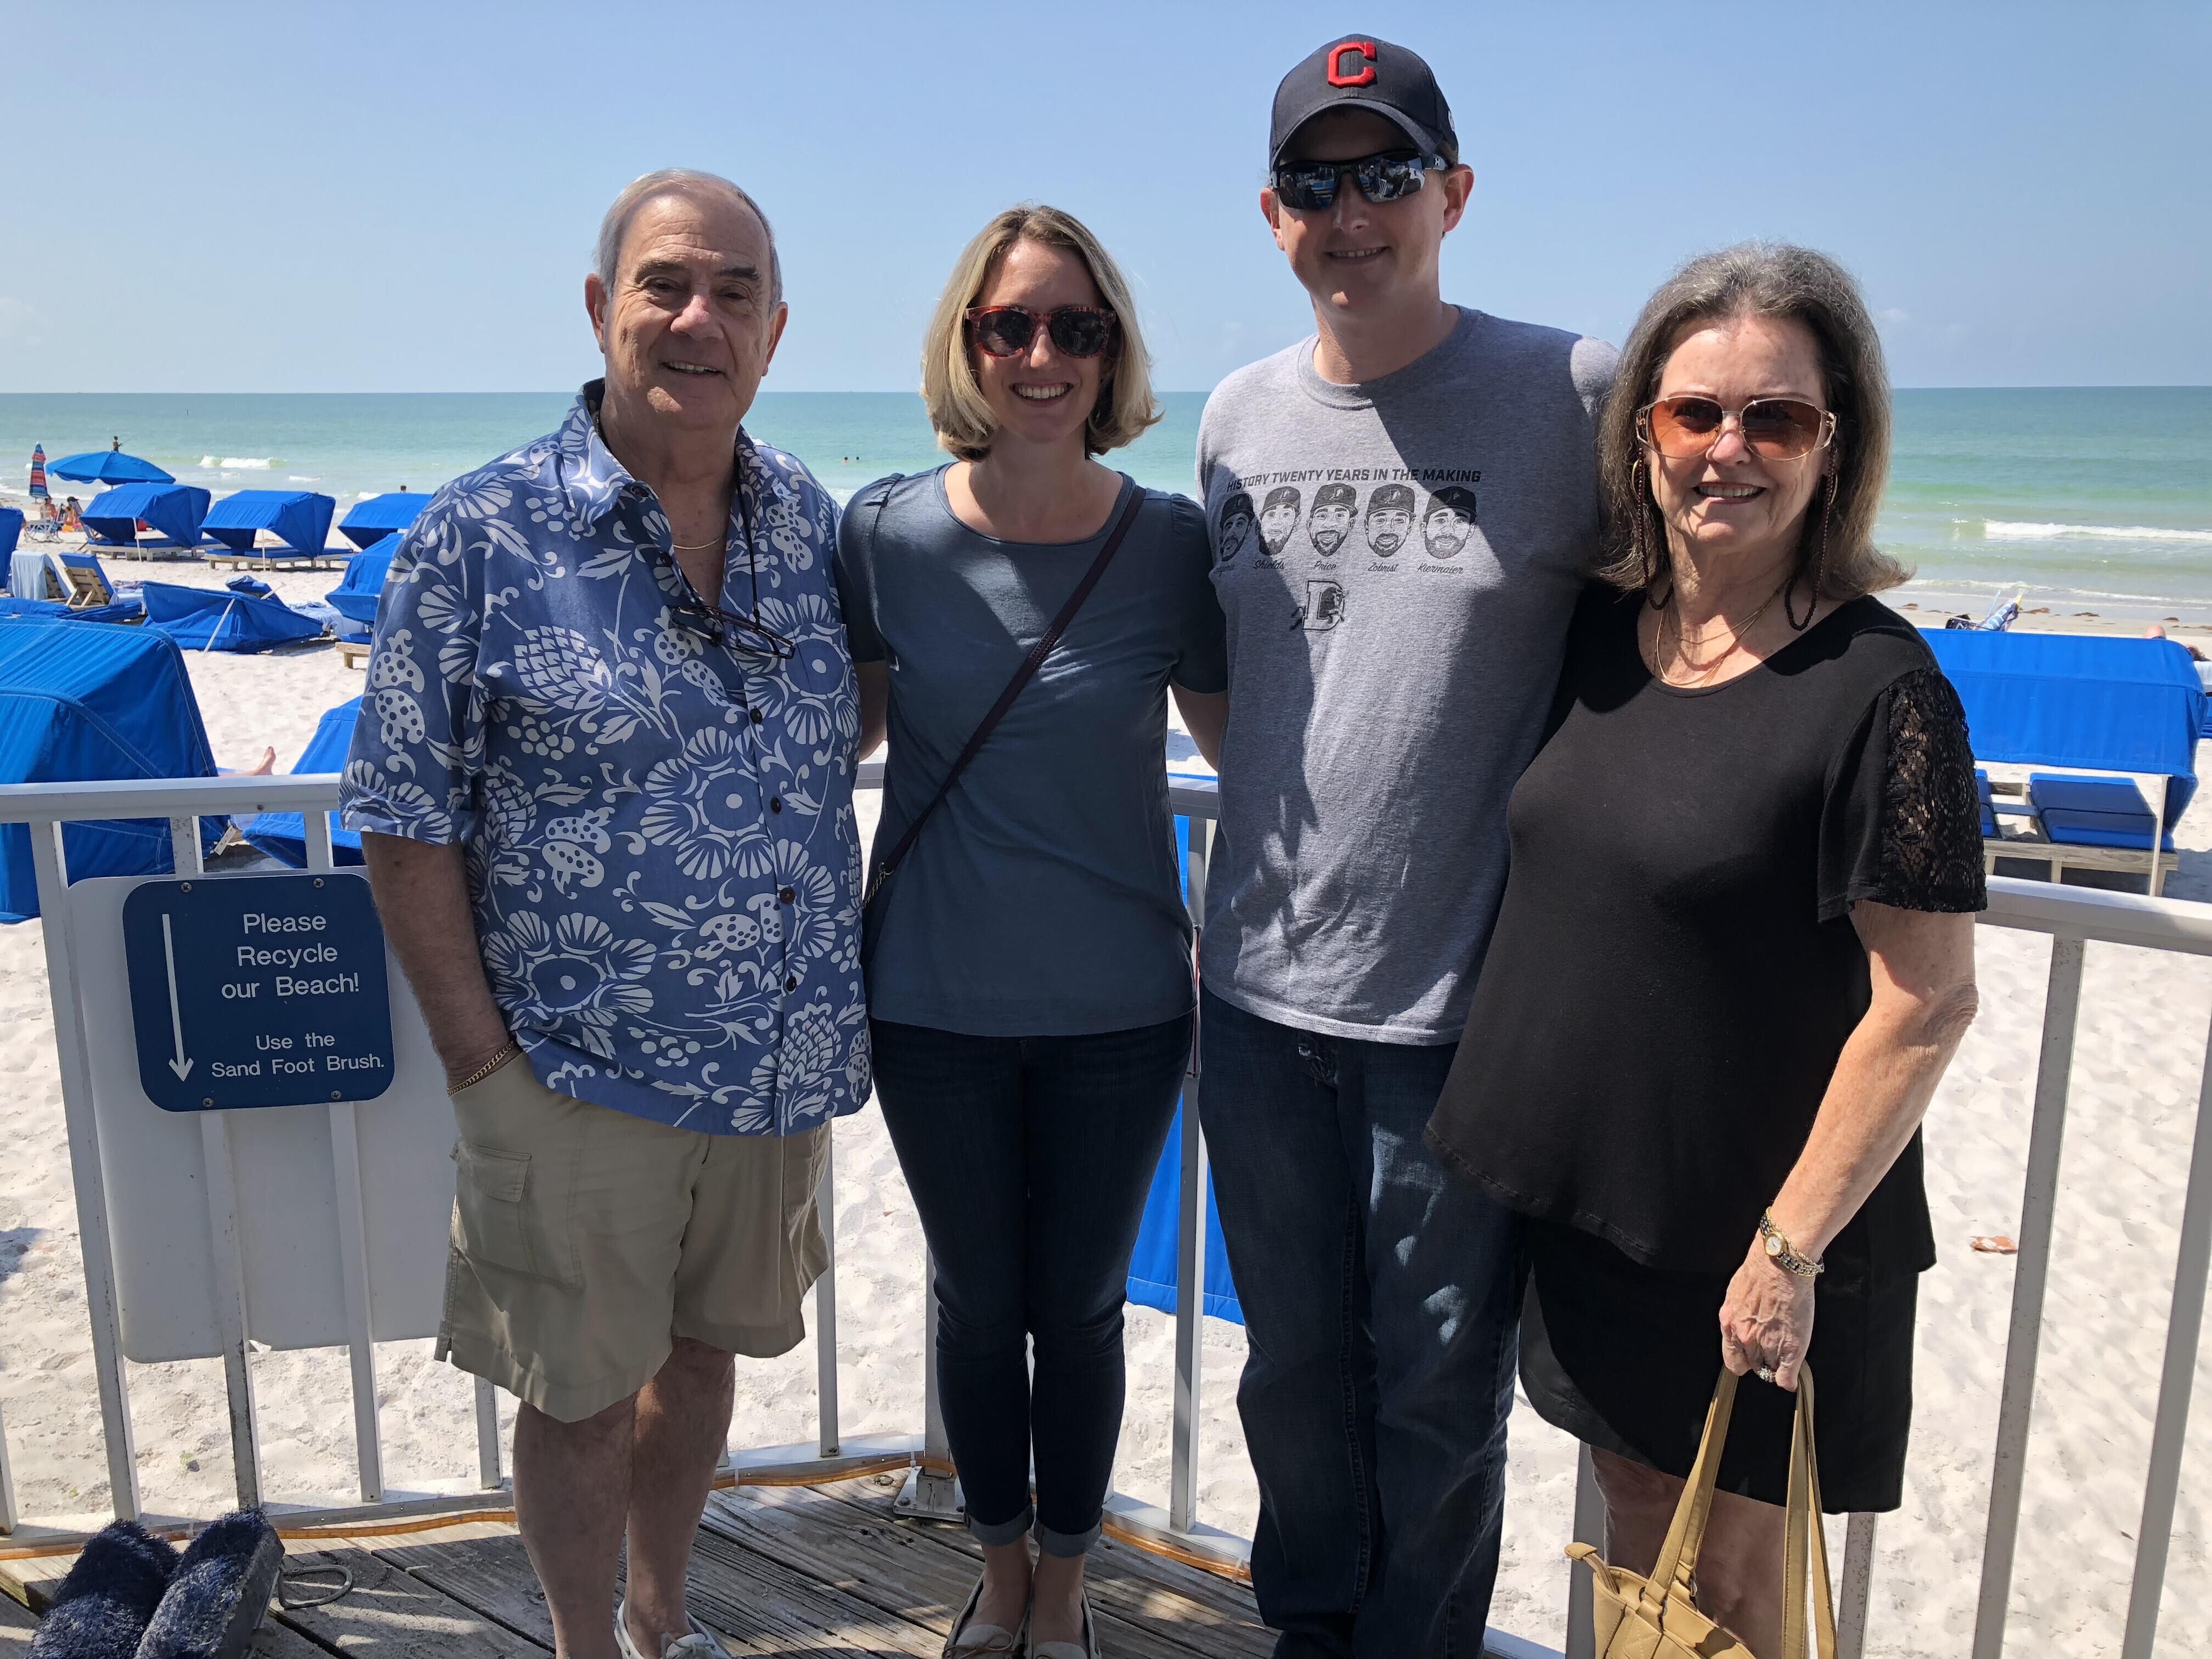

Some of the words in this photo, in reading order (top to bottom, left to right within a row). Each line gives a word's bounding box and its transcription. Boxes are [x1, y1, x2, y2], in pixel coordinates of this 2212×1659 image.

[1328, 42, 1375, 87] C
[1227, 474, 1270, 492] HISTORY
[1272, 470, 1324, 483] TWENTY
[1327, 469, 1369, 481] YEARS
[1373, 469, 1388, 481] IN
[1392, 469, 1420, 481] THE
[1422, 469, 1481, 482] MAKING
[1253, 560, 1285, 571] Shields
[1313, 561, 1337, 571] Price
[1368, 561, 1399, 572] Zobrist
[1417, 562, 1464, 574] Kiermaier
[243, 913, 327, 934] Please
[237, 943, 338, 968] Recycle
[221, 981, 261, 999] our
[275, 973, 360, 996] Beach!
[256, 1035, 293, 1051] Use
[304, 1032, 336, 1048] the
[211, 1060, 261, 1078] Sand
[272, 1058, 315, 1075] Foot
[327, 1053, 384, 1071] Brush.
